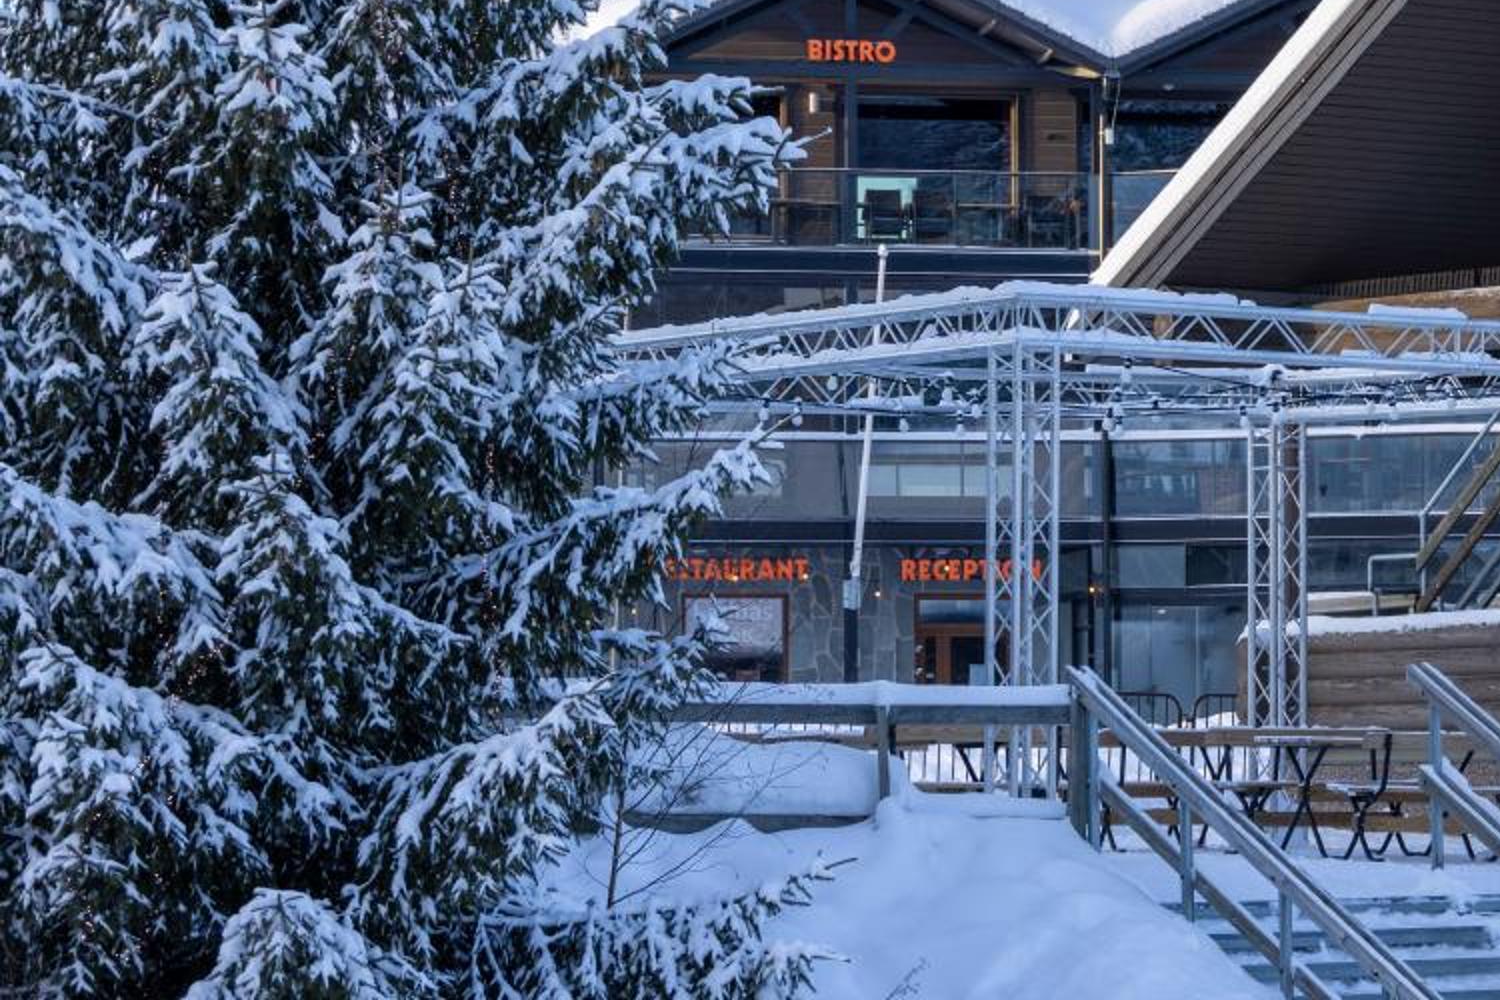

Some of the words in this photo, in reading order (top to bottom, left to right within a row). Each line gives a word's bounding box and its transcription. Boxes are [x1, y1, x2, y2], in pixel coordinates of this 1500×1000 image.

[806, 39, 897, 63] BISTRO
[662, 557, 809, 583] TAURANT
[901, 558, 1042, 582] RECEPT
